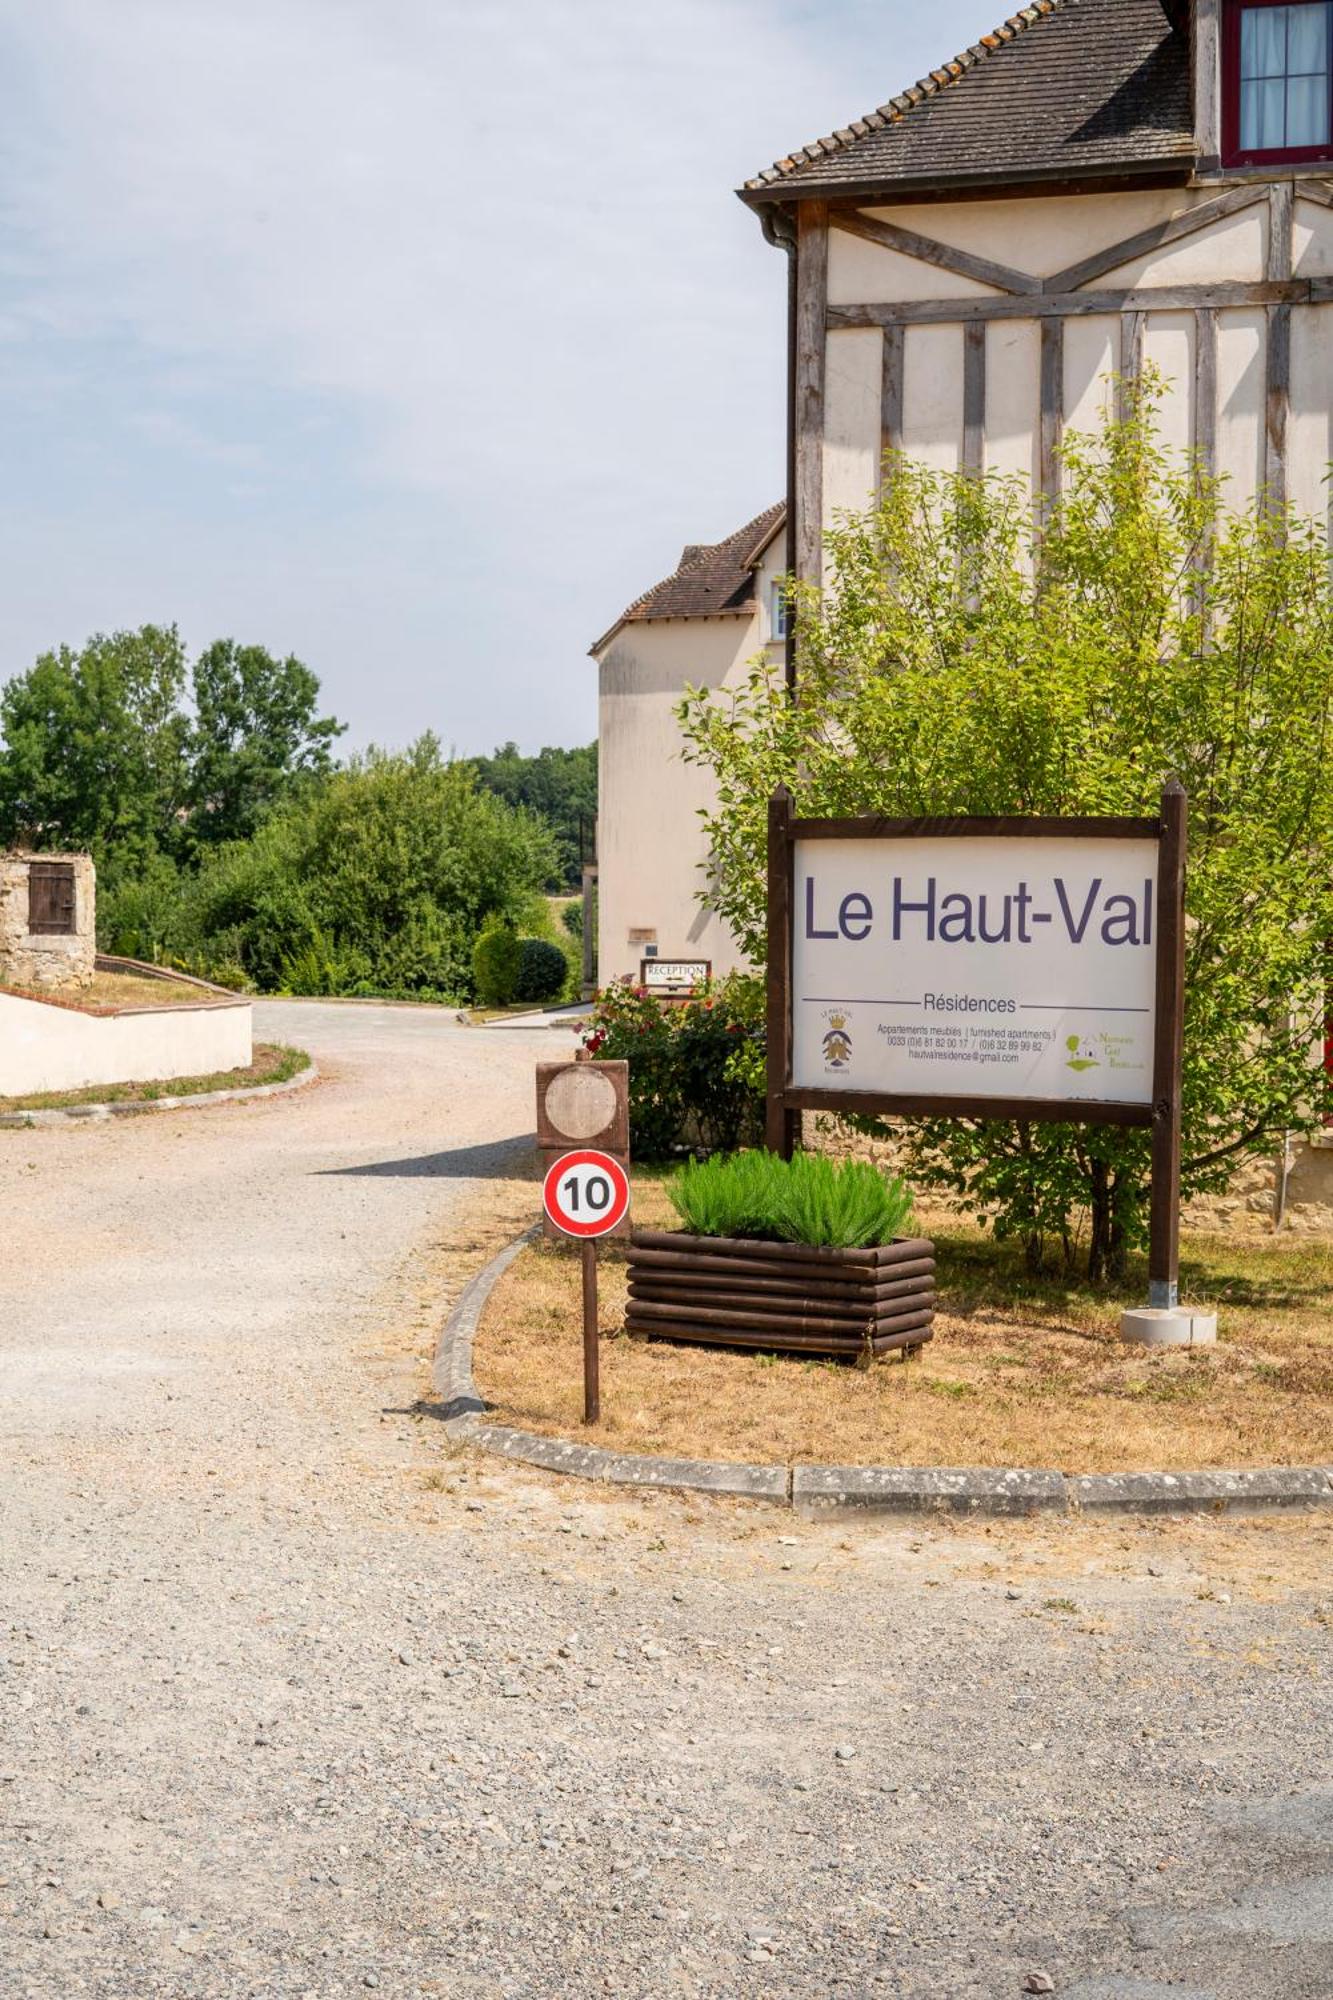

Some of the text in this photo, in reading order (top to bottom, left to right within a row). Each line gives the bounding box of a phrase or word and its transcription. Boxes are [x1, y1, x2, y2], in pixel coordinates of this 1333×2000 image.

[805, 876, 1153, 946] Le Haut-Val
[923, 992, 1017, 1013] Résidences
[877, 1023, 929, 1035] Appartements
[563, 1176, 610, 1211] 10
